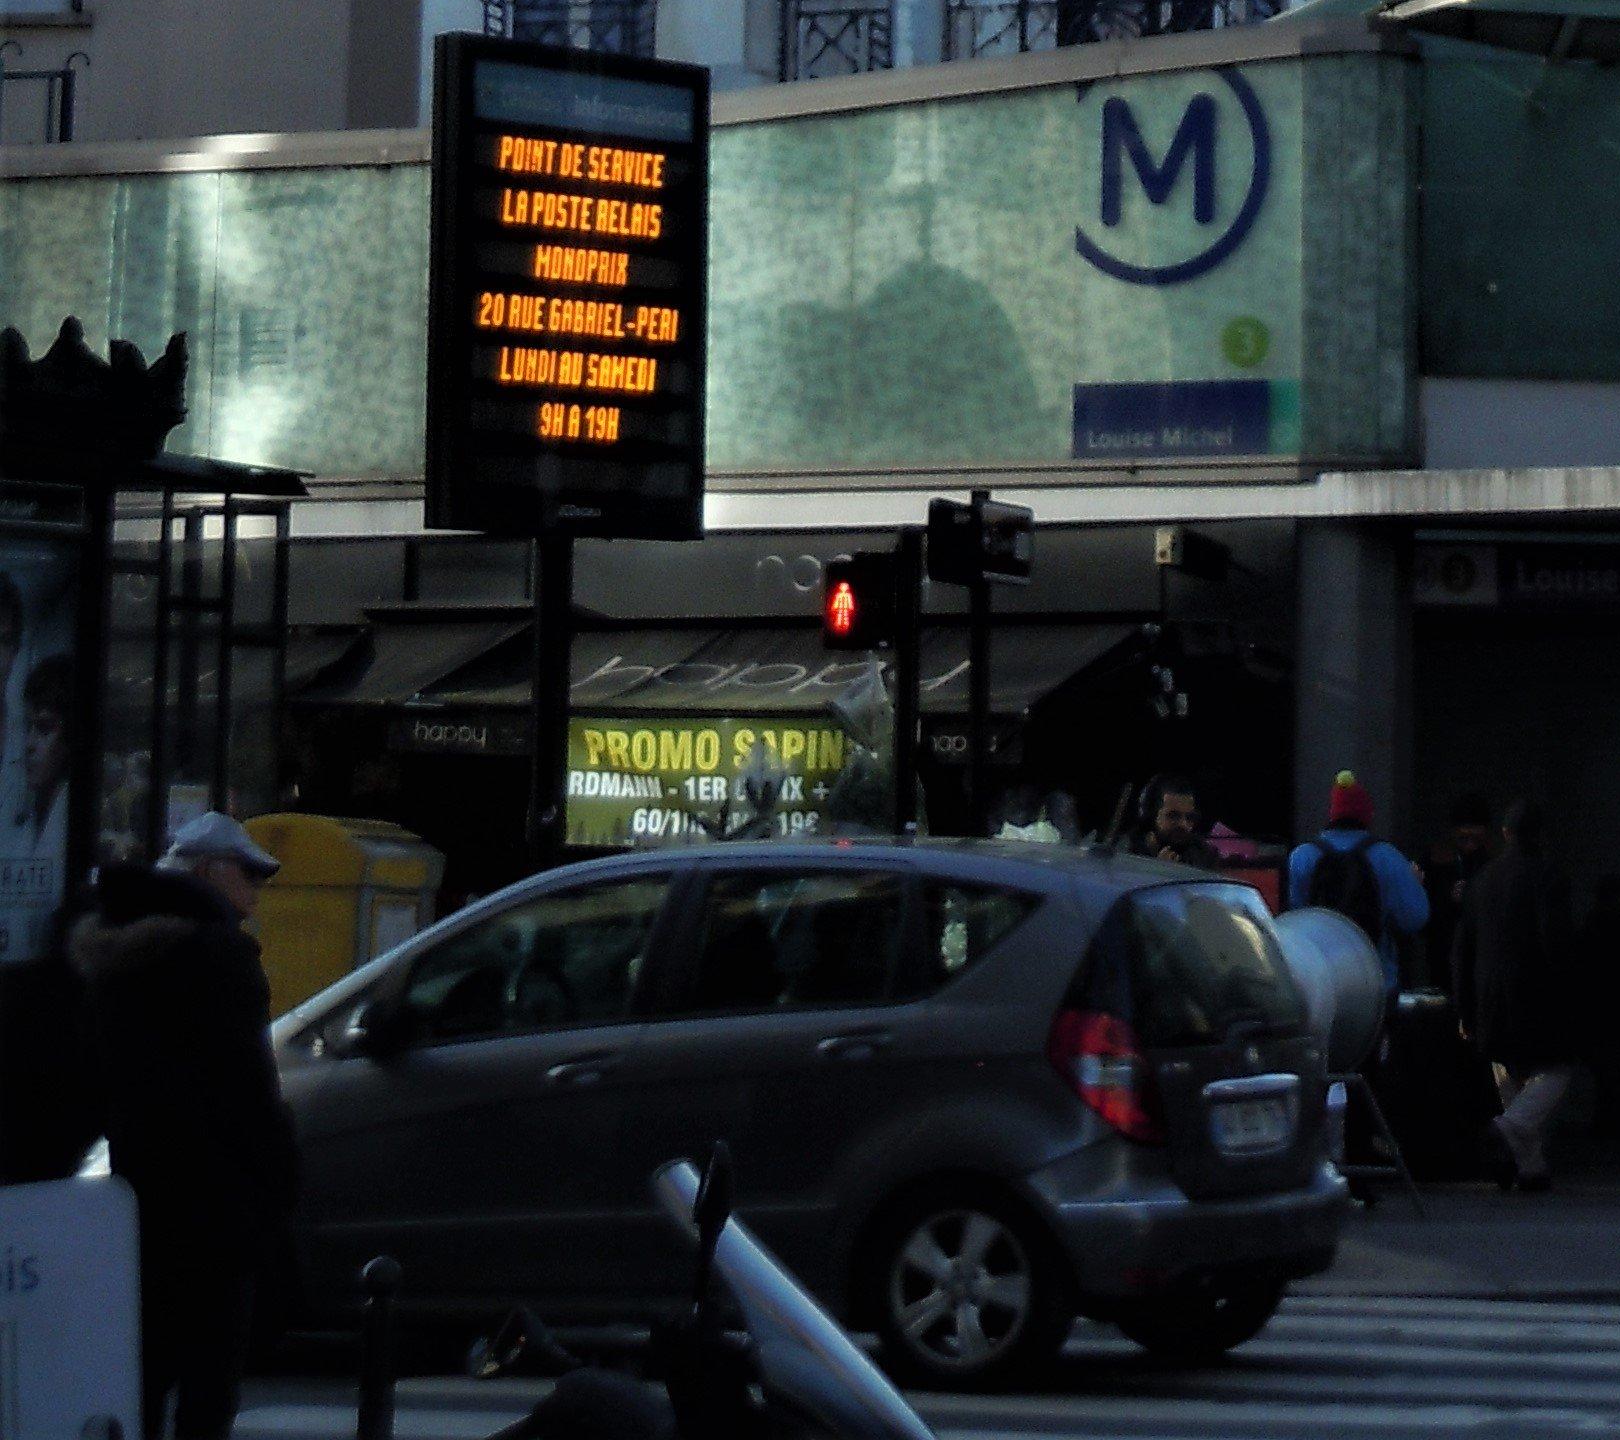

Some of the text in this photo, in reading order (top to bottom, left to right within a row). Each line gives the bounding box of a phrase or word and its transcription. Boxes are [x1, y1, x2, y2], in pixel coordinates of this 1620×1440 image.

[498, 134, 666, 188] POINT DE SERVICE
[1100, 93, 1217, 227] M
[502, 187, 663, 239] LA POSTE RELAIS
[534, 243, 630, 286] MONOPRIX
[478, 291, 680, 342] 20 RUE GABRIEL-PERI
[499, 346, 658, 392] LUNDI AU SAMEDI
[538, 401, 621, 441] 9H A 19H
[1087, 425, 1234, 449] Louise Michel
[1516, 559, 1620, 593] Louise
[584, 728, 721, 771] PROMO
[684, 775, 728, 802] 1ER
